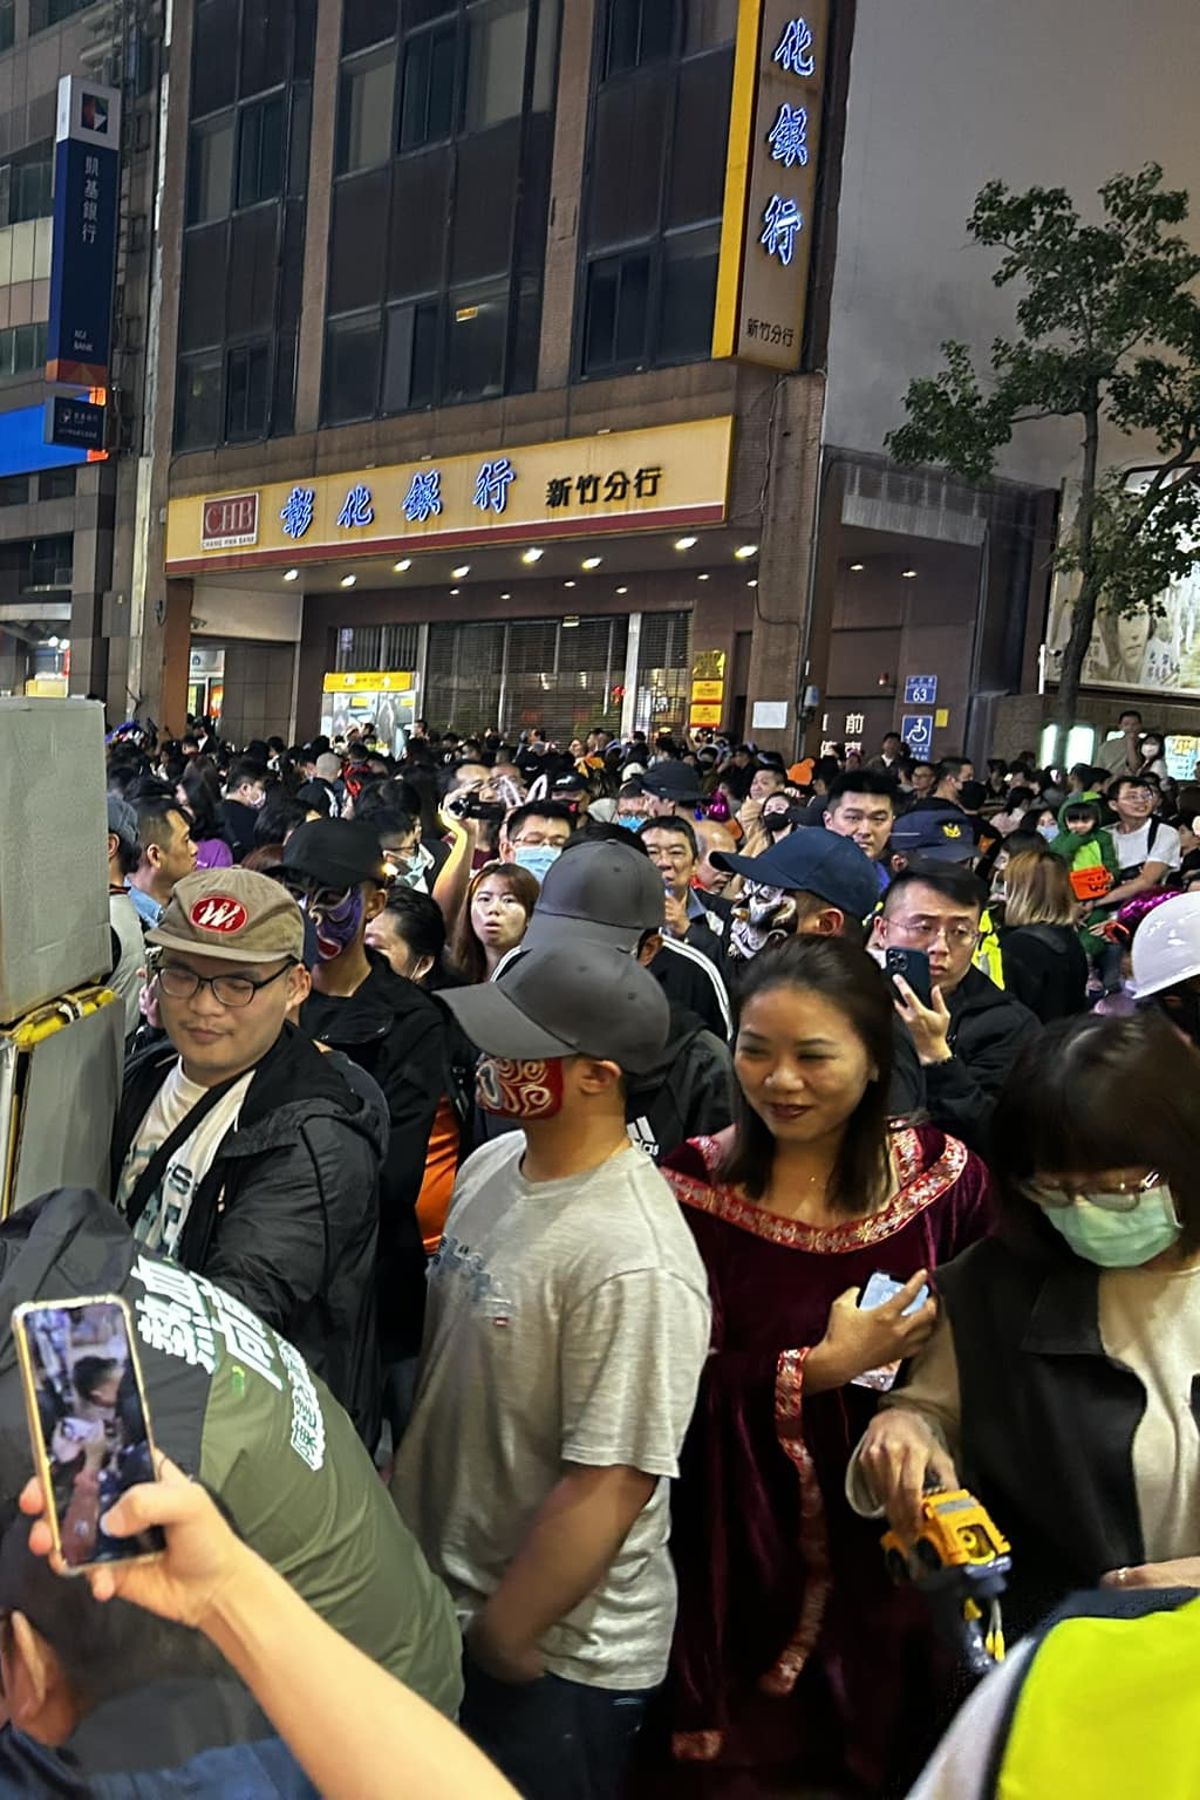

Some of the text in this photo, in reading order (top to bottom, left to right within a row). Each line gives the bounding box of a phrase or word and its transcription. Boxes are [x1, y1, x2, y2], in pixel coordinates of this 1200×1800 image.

[745, 317, 795, 348] 新竹分行
[279, 457, 517, 540] 彰化銀行
[545, 465, 664, 508] 新竹分行
[205, 500, 253, 535] CHB
[912, 687, 927, 702] 63
